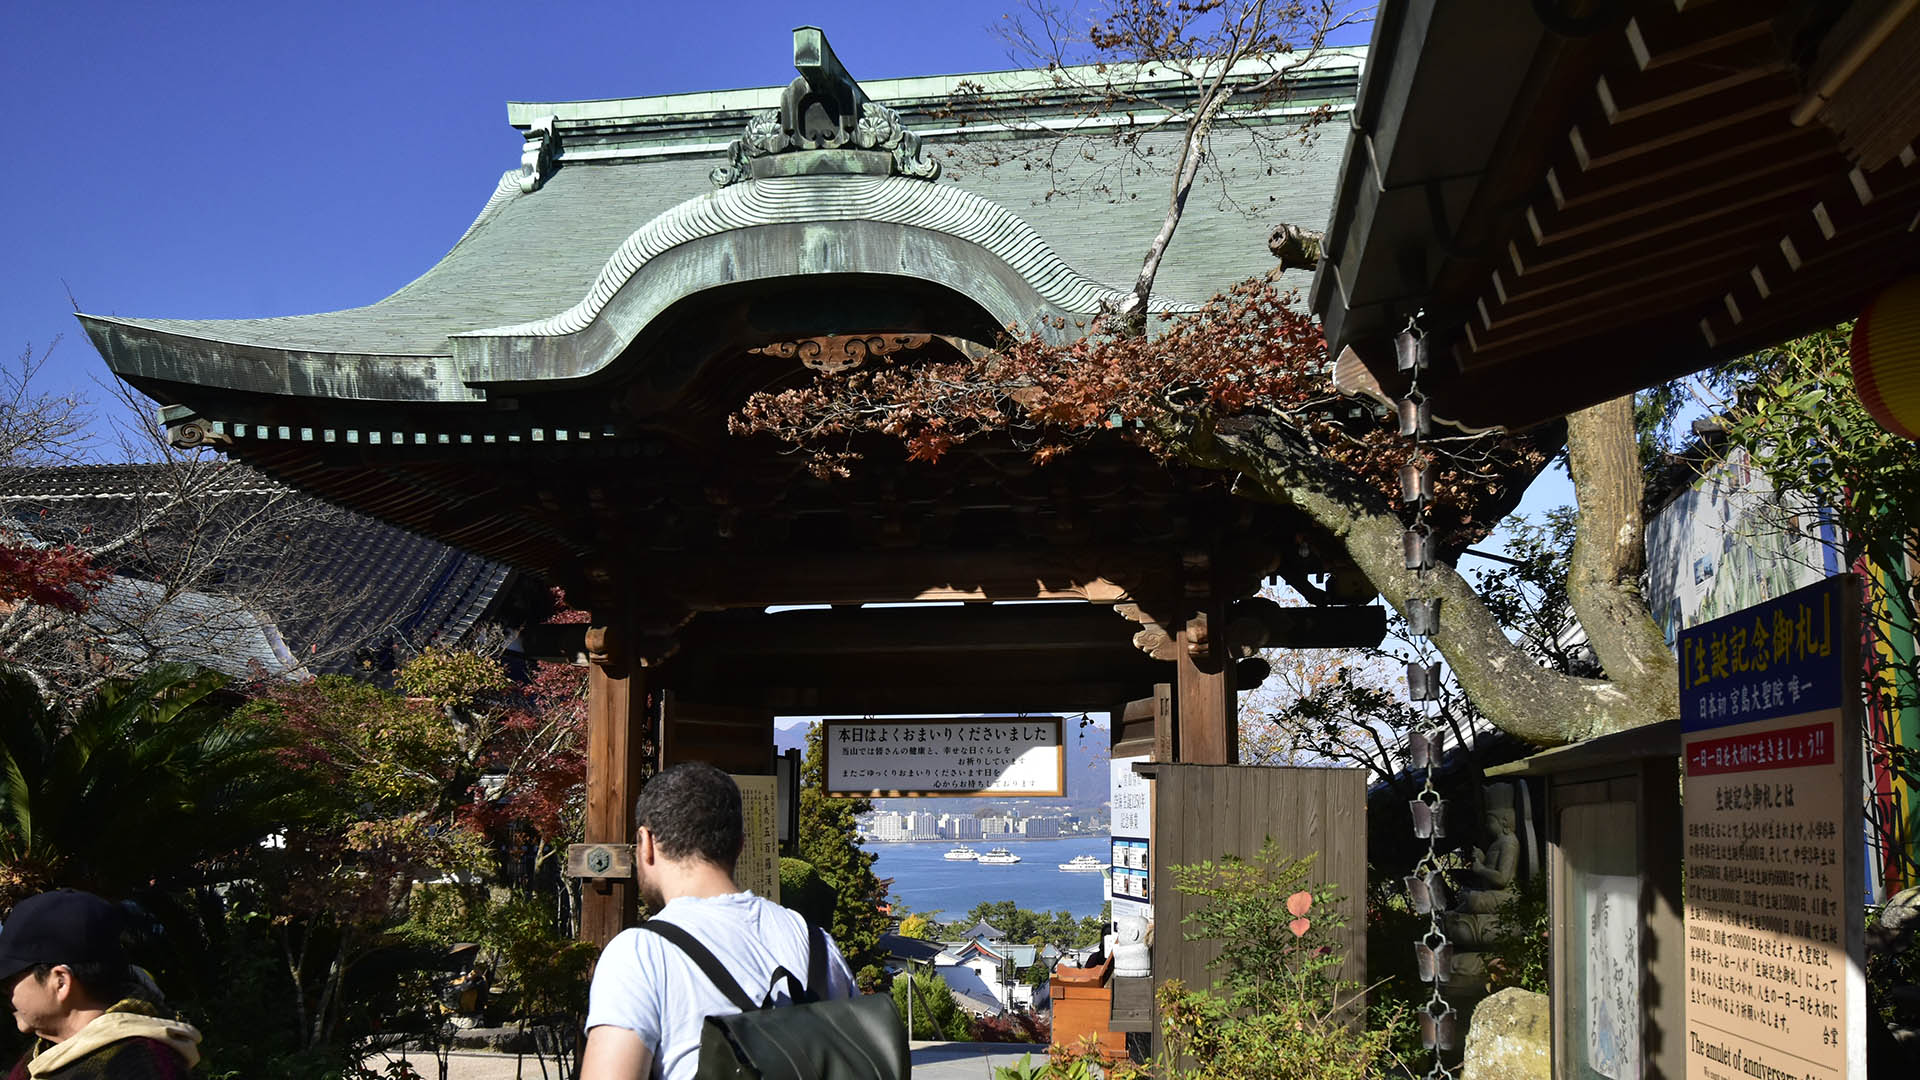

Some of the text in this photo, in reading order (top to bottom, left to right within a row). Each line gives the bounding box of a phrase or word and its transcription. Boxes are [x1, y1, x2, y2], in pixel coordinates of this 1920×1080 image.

[1684, 592, 1832, 690] 『生誕記念御札』
[1699, 675, 1813, 720] 日本初 宮島大聖院 唯一
[838, 726, 1046, 743] 本日はよくおまいりくださいました
[841, 768, 1001, 778] またごゆっくりおまいりくださいます日を
[1715, 783, 1795, 812] 生誕記念御札とは
[1690, 1030, 1704, 1056] The
[1706, 1042, 1731, 1067] amulet
[1733, 1049, 1742, 1071] of
[1743, 1056, 1797, 1080] anniversa
